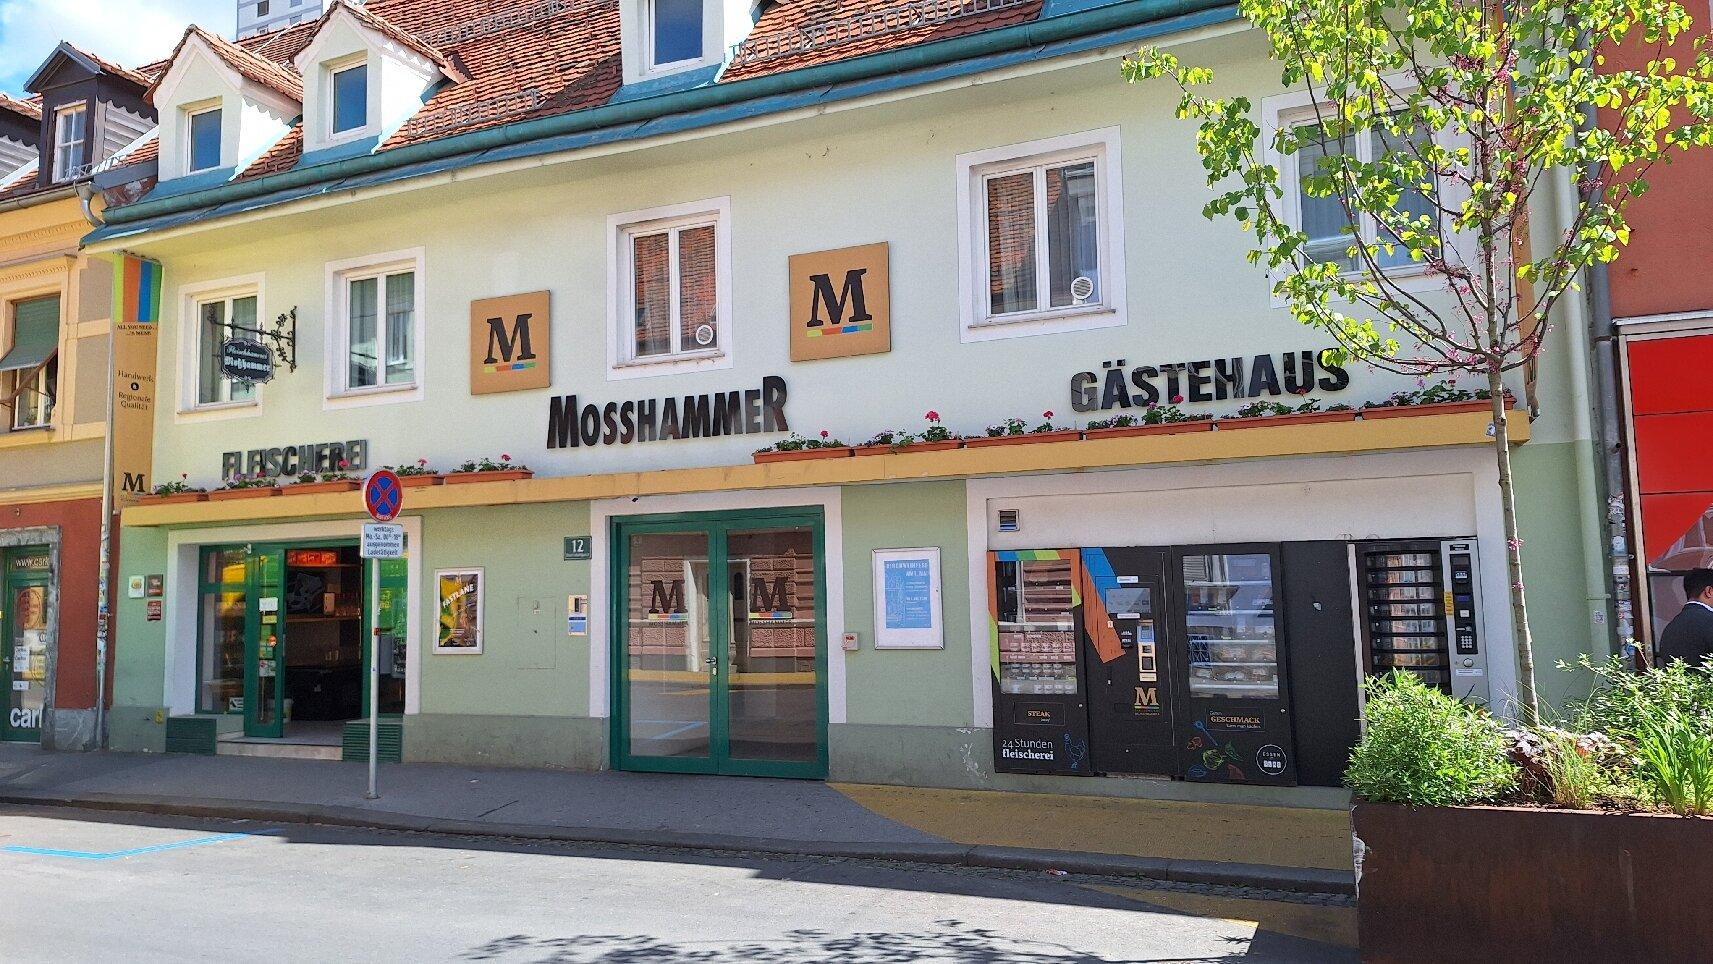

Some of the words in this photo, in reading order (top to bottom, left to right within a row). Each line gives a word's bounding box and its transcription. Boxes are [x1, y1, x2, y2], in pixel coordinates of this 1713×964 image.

[806, 268, 872, 328] M
[484, 313, 536, 365] M
[1071, 347, 1350, 413] GÄSTEHAUS
[547, 375, 789, 449] MOSSHAMMER
[222, 439, 368, 480] FLEISCHEREI
[121, 472, 146, 492] M
[572, 540, 584, 553] 12
[442, 584, 475, 608] FASTLANE
[649, 580, 688, 614] M
[749, 576, 789, 612] M
[1134, 687, 1159, 705] M
[1210, 716, 1261, 724] GESCHMACK
[1002, 739, 1014, 749] 24
[1015, 738, 1053, 749] Stunden
[1002, 748, 1054, 760] fleischerei
